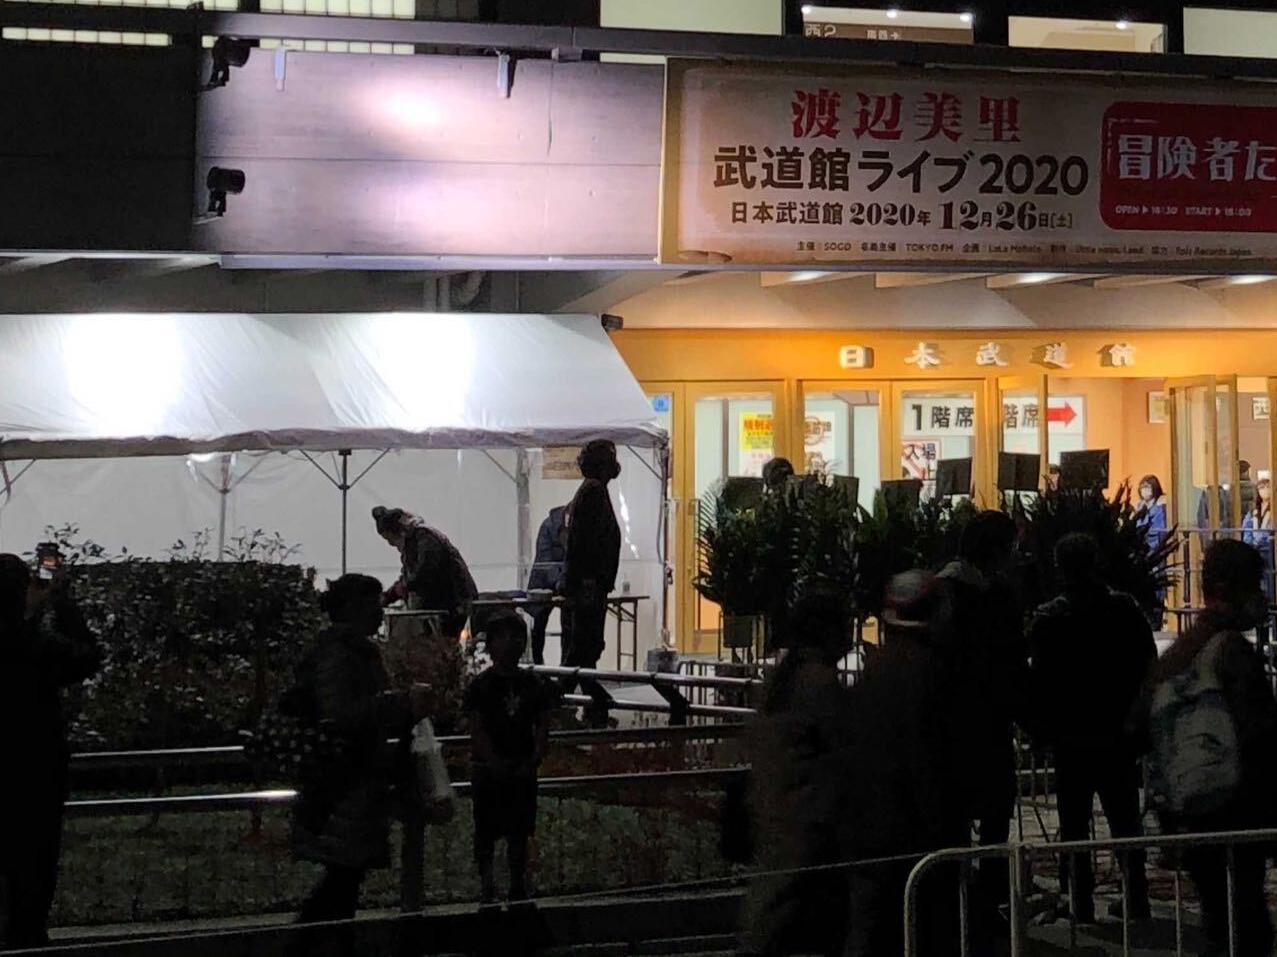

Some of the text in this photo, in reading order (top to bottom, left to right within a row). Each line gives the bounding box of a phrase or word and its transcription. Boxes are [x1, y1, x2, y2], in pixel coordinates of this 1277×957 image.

[791, 89, 1022, 143] 渡辺美里
[713, 145, 1089, 196] 武道館ライブ2020
